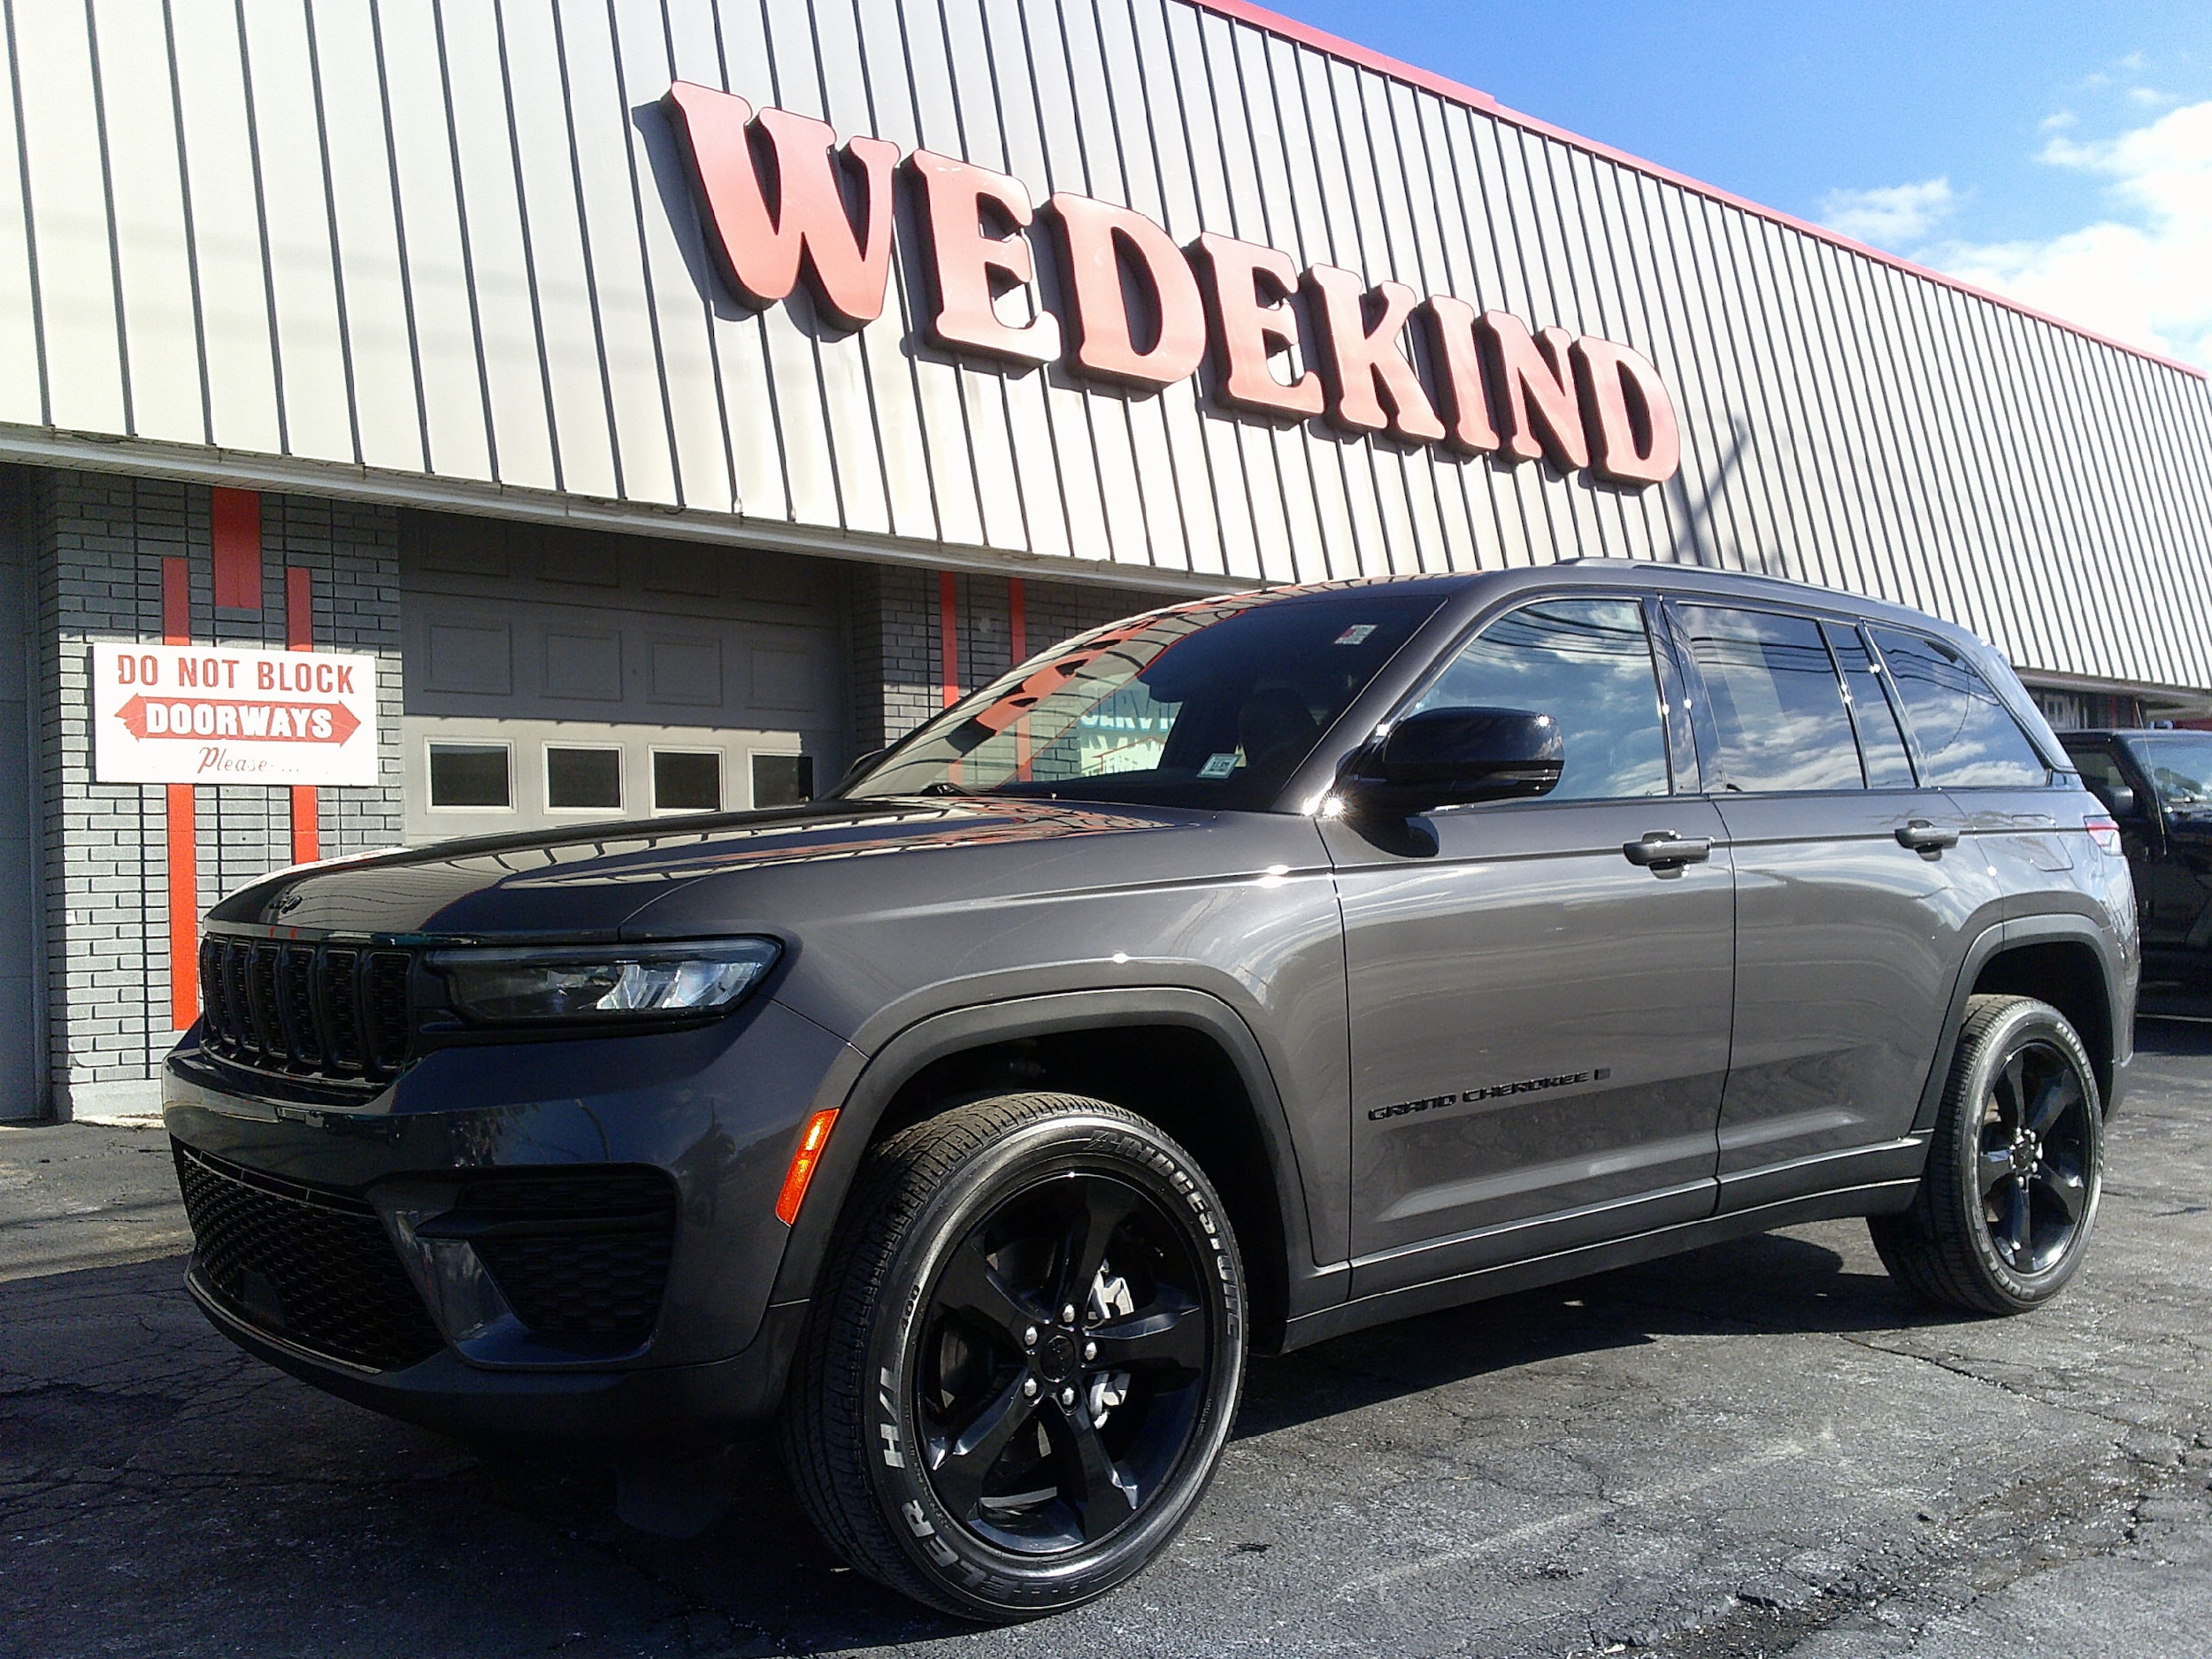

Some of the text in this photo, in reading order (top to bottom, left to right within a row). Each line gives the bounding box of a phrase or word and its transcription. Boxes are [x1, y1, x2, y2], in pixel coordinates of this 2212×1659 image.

[661, 81, 1680, 488] WEDEKIND
[118, 655, 355, 694] DO NOT BLOCK
[146, 703, 334, 739] DOORWAYS
[197, 747, 268, 774] Please
[1368, 1071, 1589, 1121] GRAND CHEROKEE
